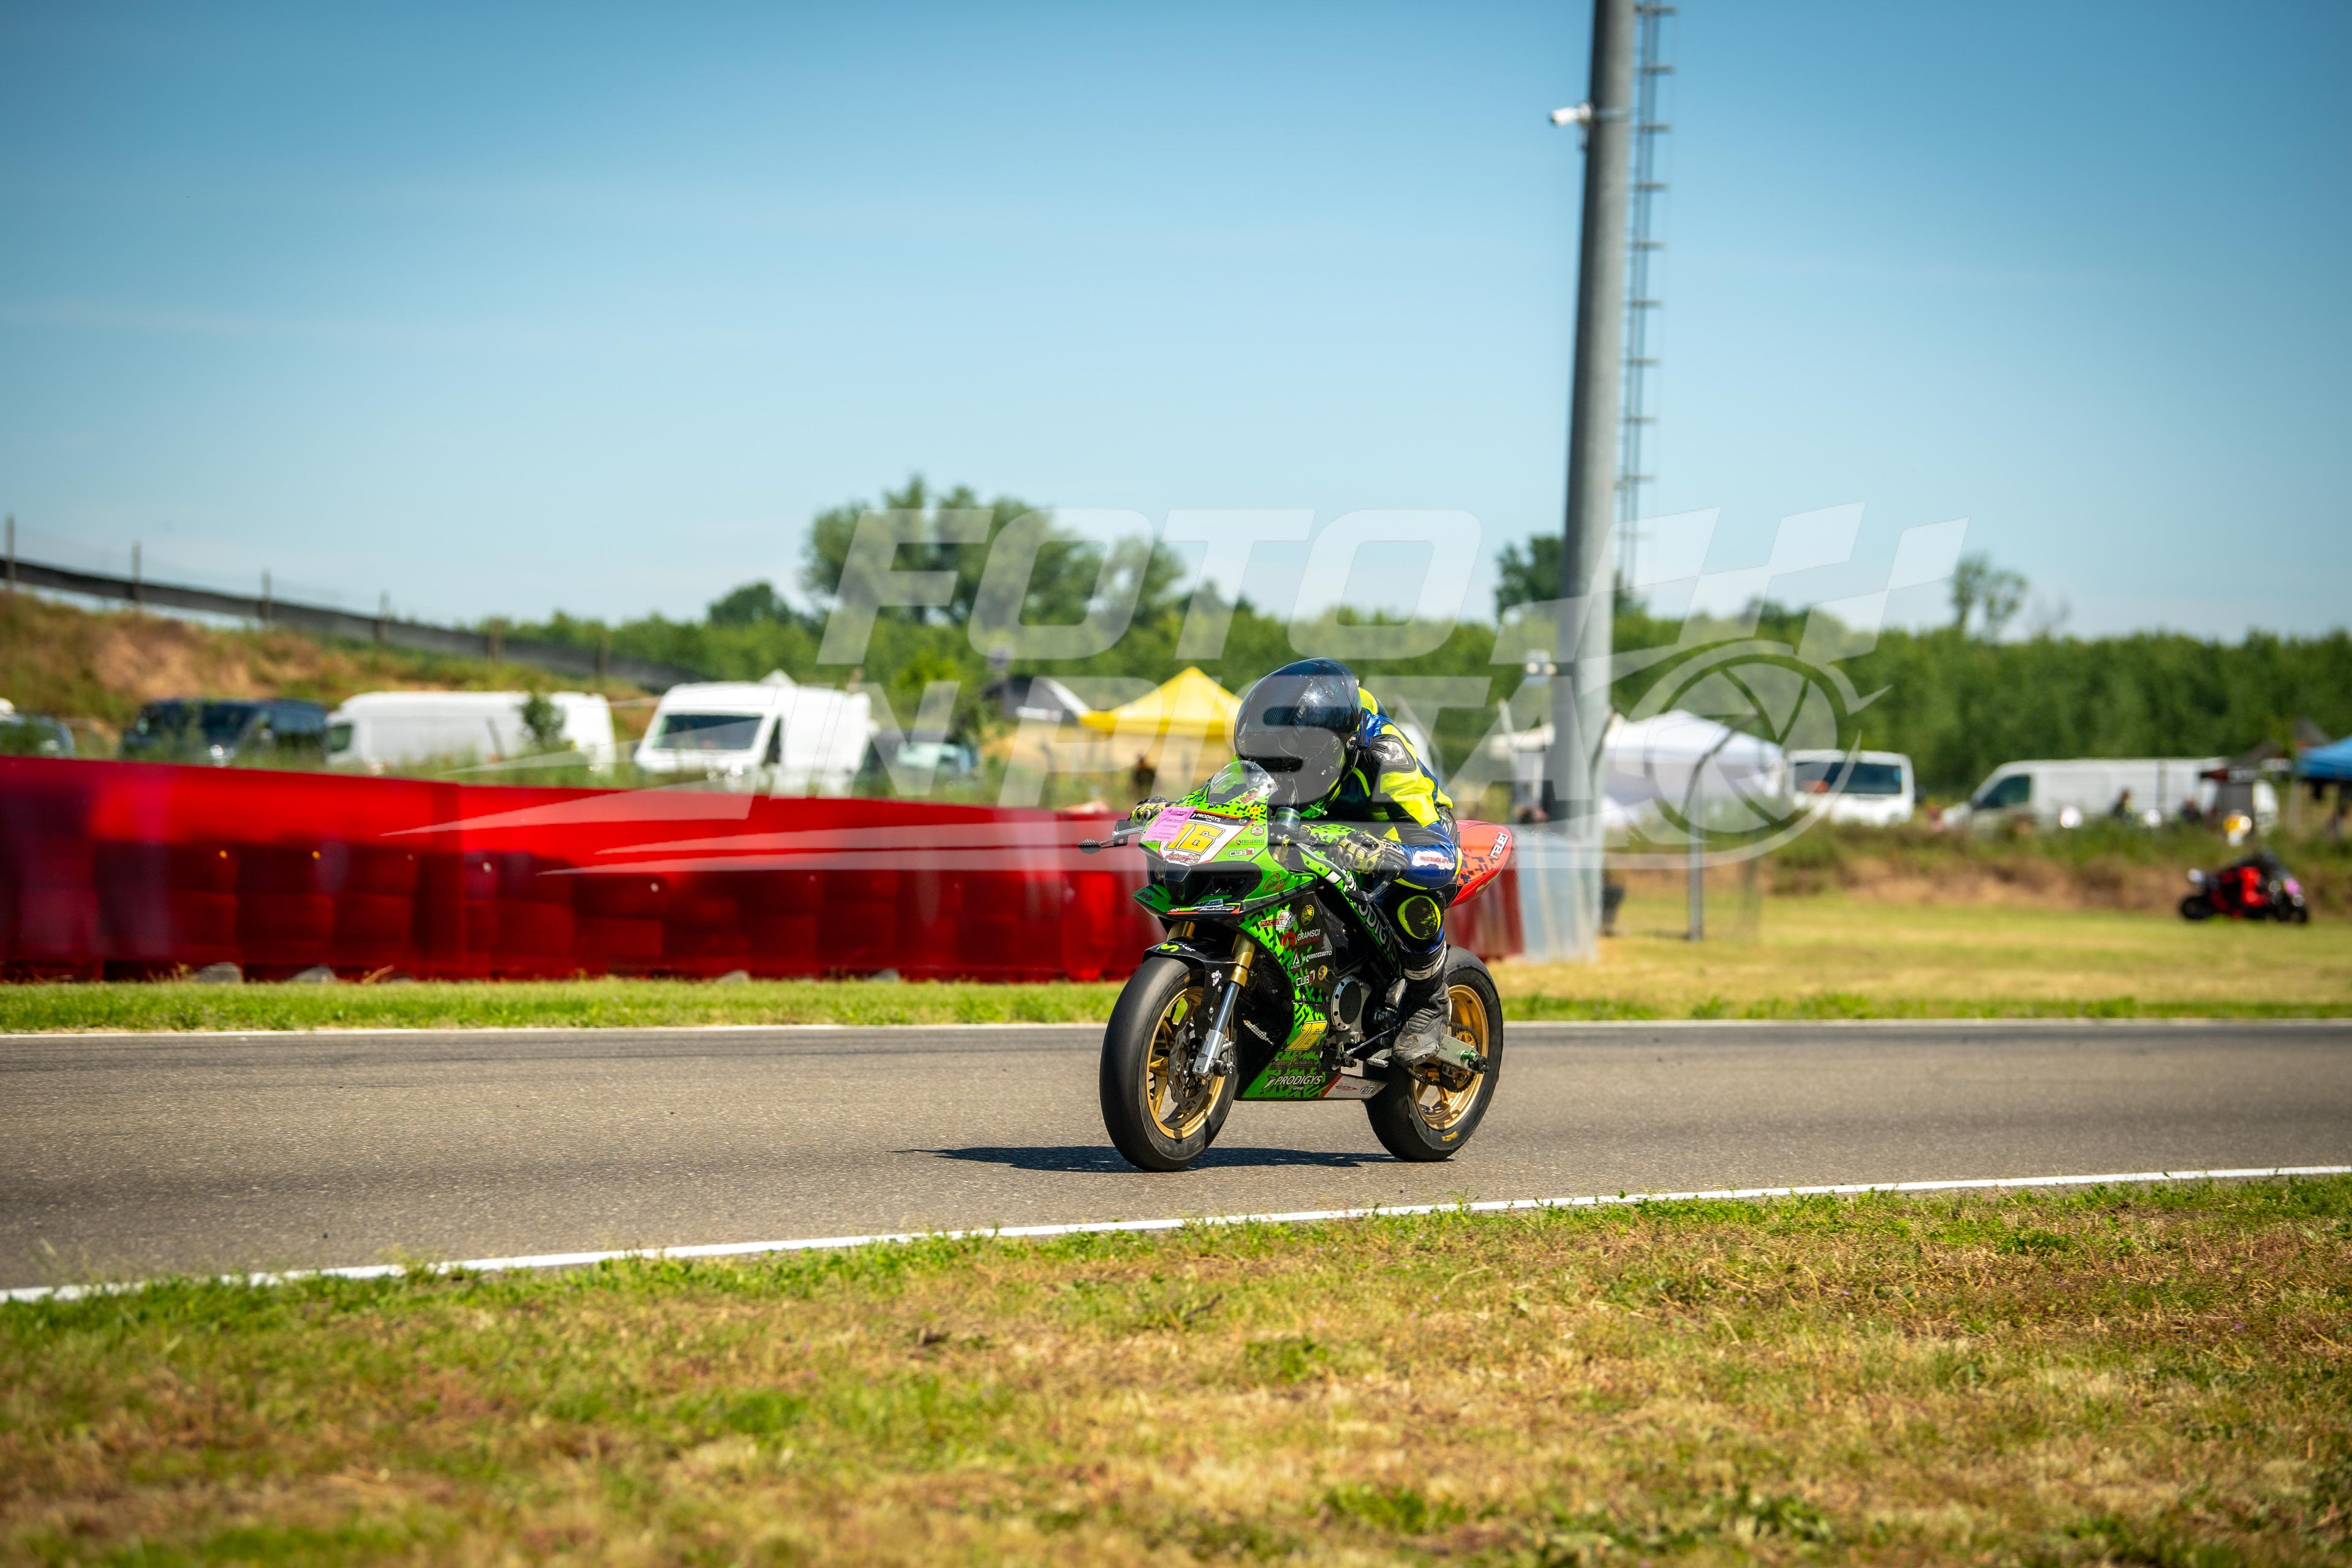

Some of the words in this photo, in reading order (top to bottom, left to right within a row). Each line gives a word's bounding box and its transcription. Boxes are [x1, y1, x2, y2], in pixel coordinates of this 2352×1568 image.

[1196, 813, 1221, 822] PRODIGYS
[1165, 822, 1226, 856] 16
[1343, 871, 1397, 962] PODIGYS
[1297, 929, 1321, 941] GRAMSCI
[1285, 1020, 1327, 1051] 16
[1274, 1075, 1324, 1085] PRODIGYS
